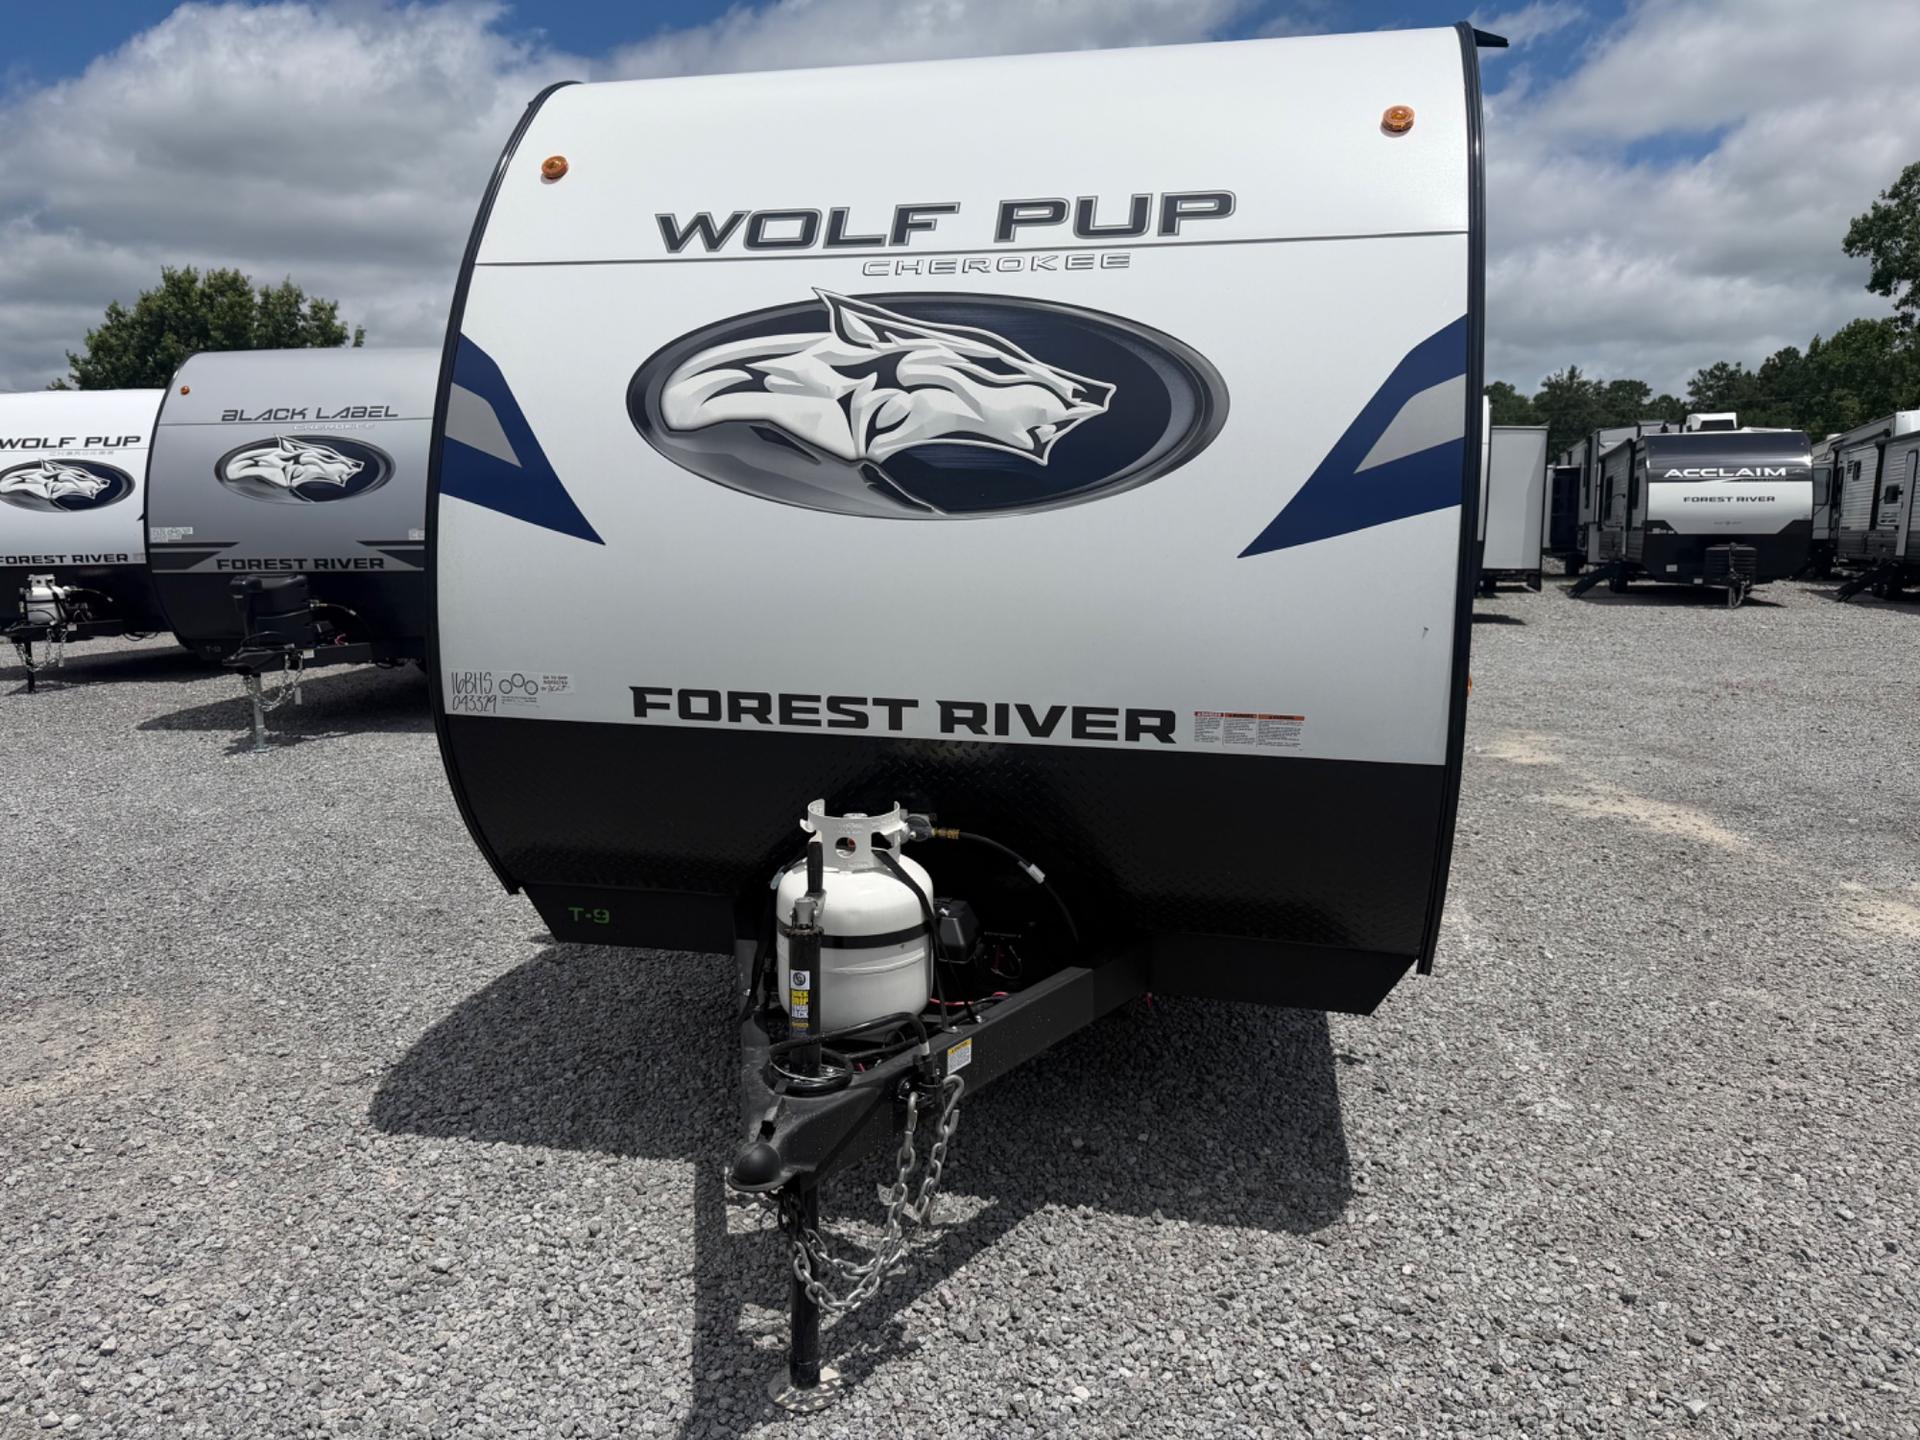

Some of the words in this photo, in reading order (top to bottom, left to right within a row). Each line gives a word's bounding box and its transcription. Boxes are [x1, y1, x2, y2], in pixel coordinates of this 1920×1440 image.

[654, 201, 961, 254] WOLF
[993, 189, 1236, 244] PUP
[861, 251, 1132, 277] CHEROKEE
[221, 407, 308, 422] BLACK
[316, 405, 399, 420] LABEL
[0, 436, 77, 450] WOLF
[84, 435, 141, 448] PUP
[1664, 467, 1787, 478] ACCLAIM
[1736, 495, 1776, 503] RIVER
[71, 553, 129, 564] RIVER
[216, 558, 308, 570] FOREST
[313, 557, 385, 570] RIVER
[629, 686, 919, 732] FOREST
[935, 700, 1177, 744] RIVER
[567, 906, 610, 924] T-9
